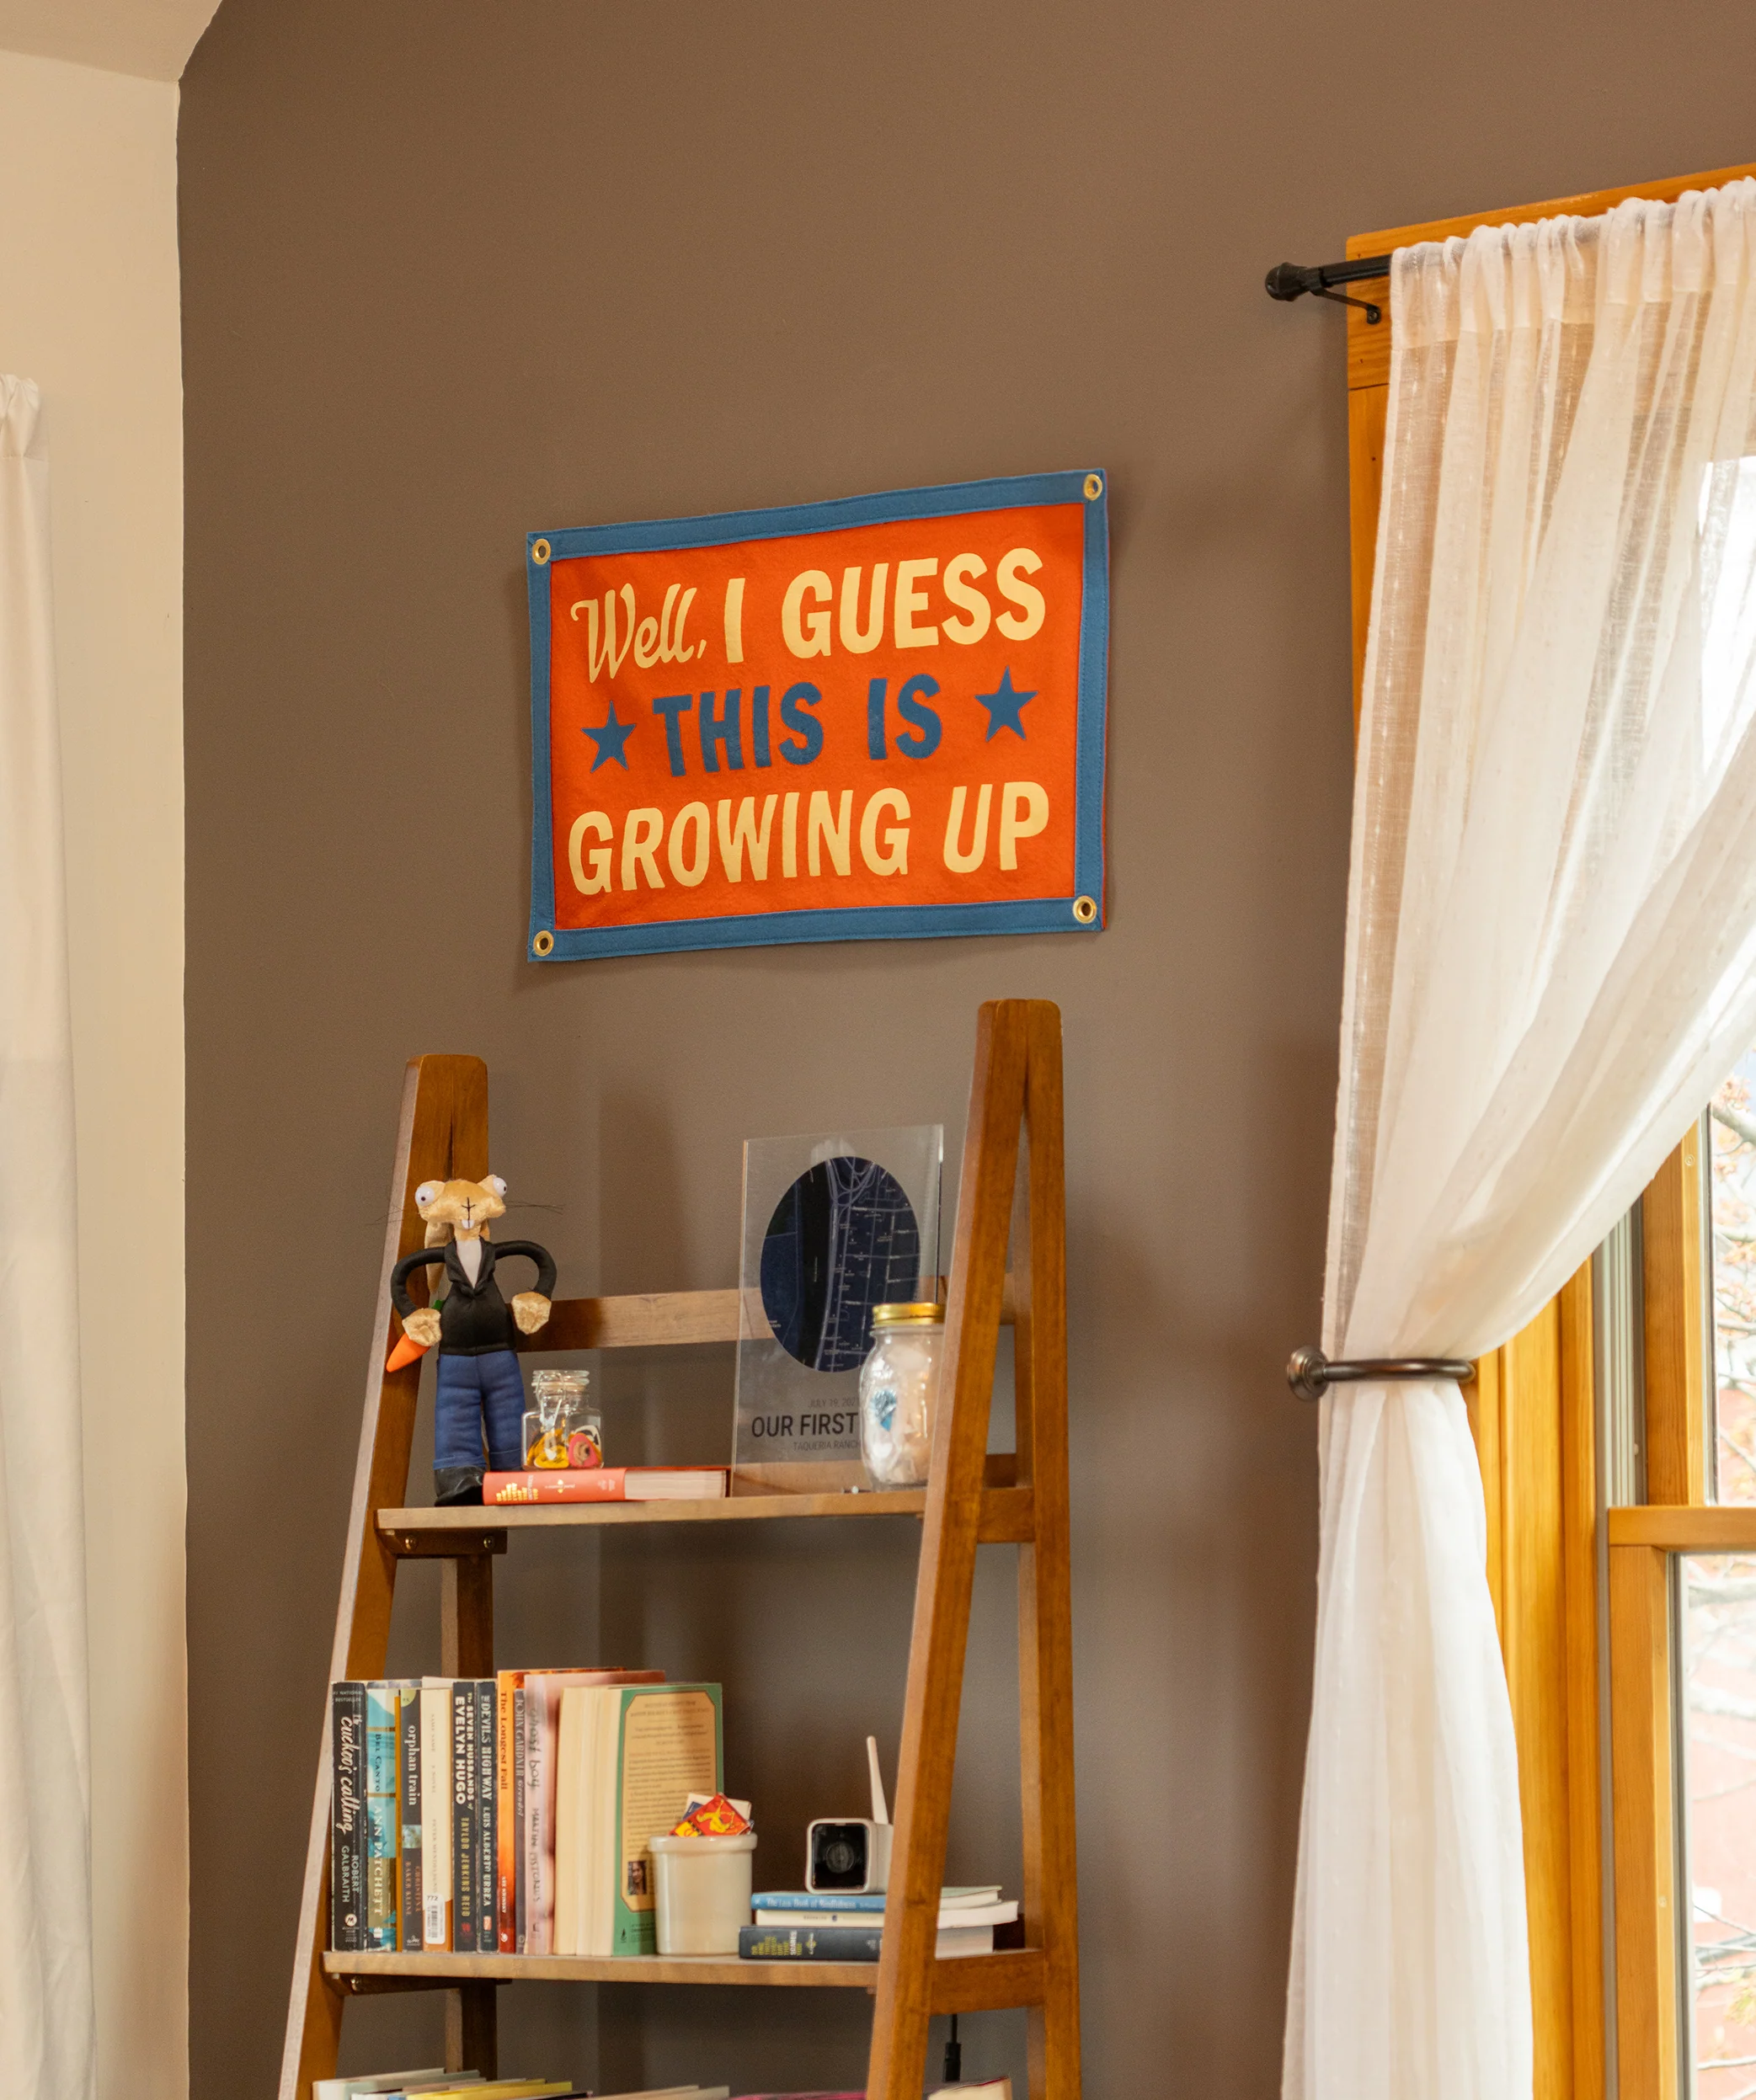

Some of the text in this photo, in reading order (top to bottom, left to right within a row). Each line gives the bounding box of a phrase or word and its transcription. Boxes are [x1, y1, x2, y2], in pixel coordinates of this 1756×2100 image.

[570, 547, 1047, 683] Well, I GUESS
[653, 674, 942, 776] THIS IS
[568, 781, 1049, 895] GROWING UP
[751, 1412, 858, 1437] OUR FIRST
[809, 1399, 827, 1408] JULY
[793, 1441, 831, 1451] TAQUERIA
[455, 1696, 466, 1805] EVELYN HUGO
[499, 1718, 508, 1764] Longest
[515, 1698, 524, 1777] JOHN GARDNER
[403, 1725, 420, 1805] orphan train
[481, 1746, 492, 1800] HIGHWAY
[527, 1760, 541, 1788] boy
[335, 1777, 360, 1835] calling
[483, 1807, 492, 1828] LUIS
[461, 1817, 470, 1850] TAYLOR
[483, 1831, 492, 1872] ALBERTO
[341, 1846, 350, 1902] GALBRAITH
[351, 1855, 360, 1894] ROBERT
[374, 1805, 383, 1916] ANN PATCHETT
[461, 1853, 470, 1892] JENKINS
[461, 1895, 470, 1916] REID
[483, 1873, 492, 1906] URREA
